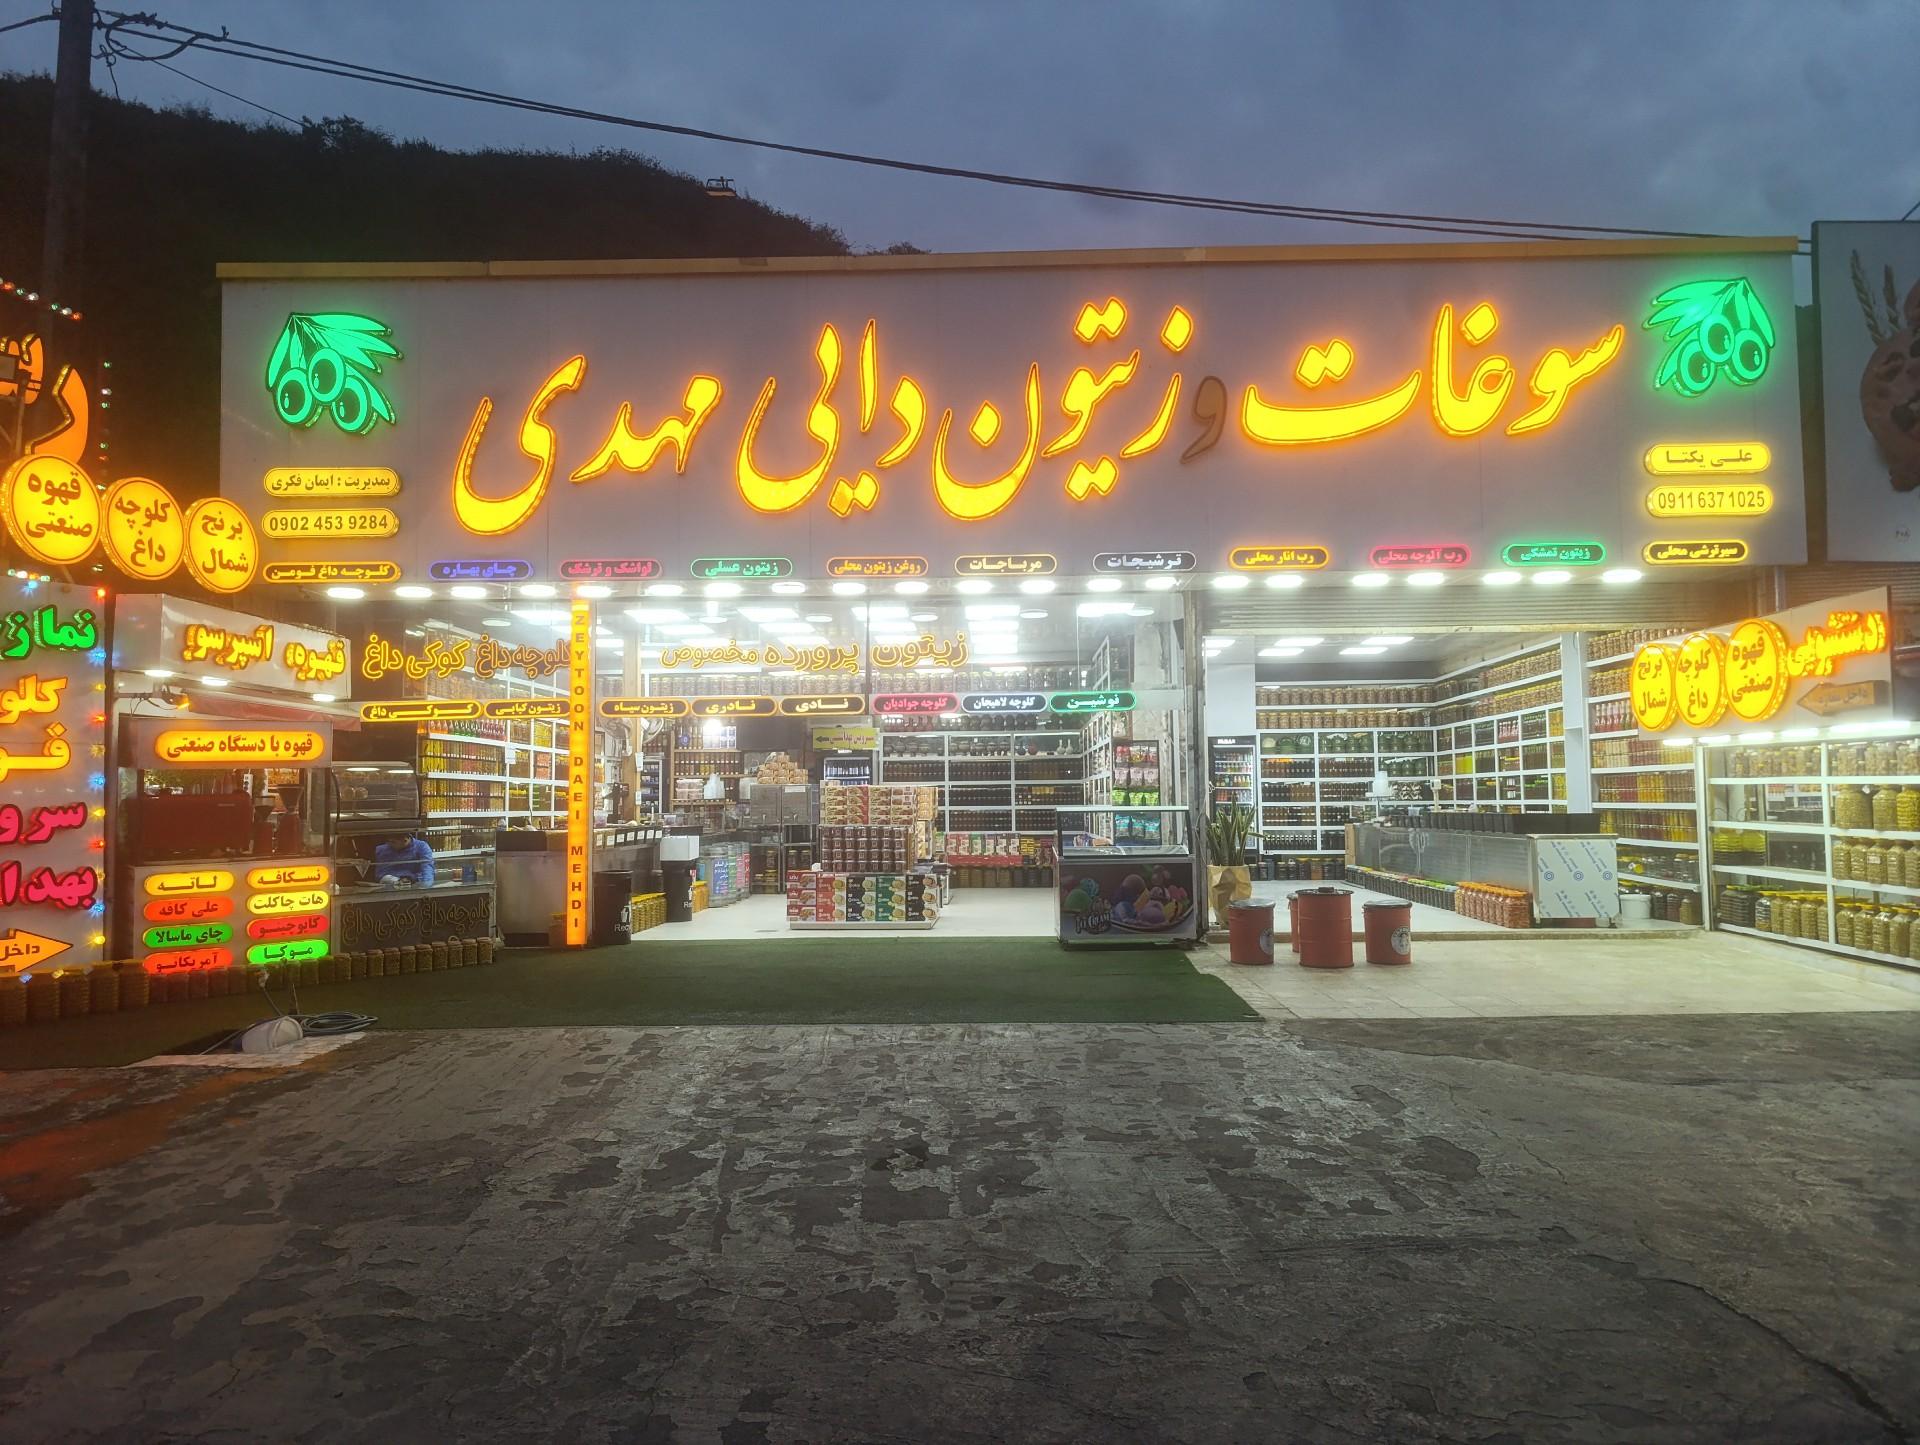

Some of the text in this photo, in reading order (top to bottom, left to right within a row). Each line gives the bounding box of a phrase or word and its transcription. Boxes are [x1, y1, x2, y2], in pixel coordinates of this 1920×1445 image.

[453, 297, 1625, 536] سوغات و زیتون دایی مهدی
[1666, 449, 1753, 468] علی یکتا
[27, 471, 82, 506] قهوه
[271, 474, 302, 491] فکری
[305, 474, 334, 490] ایمان
[1658, 490, 1765, 509] 0911 637 1025
[115, 496, 170, 529] کلوچه
[25, 512, 93, 538] صنعتی
[201, 512, 244, 541] برنج
[269, 514, 388, 531] 0902 453 9284
[131, 531, 166, 567] داغ
[1245, 551, 1314, 564] رب انار محلی
[1378, 551, 1409, 563] محلی
[1443, 551, 1463, 562] رب
[1559, 548, 1591, 560] زیتون
[1657, 545, 1688, 559] محلی
[202, 548, 249, 574] شمال
[482, 562, 517, 577] چای
[614, 561, 652, 576] لواشک
[705, 560, 778, 577] زیتون عسلی
[834, 560, 921, 575] روغن زیتون محلی
[969, 557, 1043, 572] مرباجات
[1107, 554, 1182, 570] ترشیجات
[271, 565, 390, 579] کلوچه داغ فومن
[188, 625, 345, 680] قهوه اسپرسو
[363, 633, 404, 679] داغ
[474, 634, 513, 679] داغ
[660, 632, 969, 675] زیتون پرورده مخصوص
[1732, 629, 1766, 670] قهوه
[407, 640, 471, 679] کوکی
[1678, 650, 1711, 682] کلوچه
[1638, 658, 1663, 680] برنج
[1732, 673, 1773, 703] صنعتی
[495, 703, 561, 716] زیتون کبابی
[614, 702, 674, 714] زیتون سیاه
[706, 700, 755, 713] نادری
[795, 698, 849, 712] نادی
[883, 698, 948, 711] کلوچه جوادیان
[973, 696, 1036, 710] کلوچه لاهیجان
[1639, 687, 1667, 716] شمال
[1687, 685, 1708, 718] داغ
[369, 704, 474, 719] کوکی داغ
[167, 733, 313, 758] قهوه با دستگاه صنعتی
[571, 615, 585, 928] ZEYTOON DAEI MEHDI
[157, 875, 218, 891] لاته
[258, 869, 321, 884] نسکافه
[159, 901, 218, 918] علی کافه
[254, 894, 324, 910] هات چاکلت
[156, 927, 223, 943] چای ماسالا
[259, 917, 321, 938] کاپوچینو
[264, 945, 313, 959] موکا
[156, 952, 220, 973] آمریکانو
